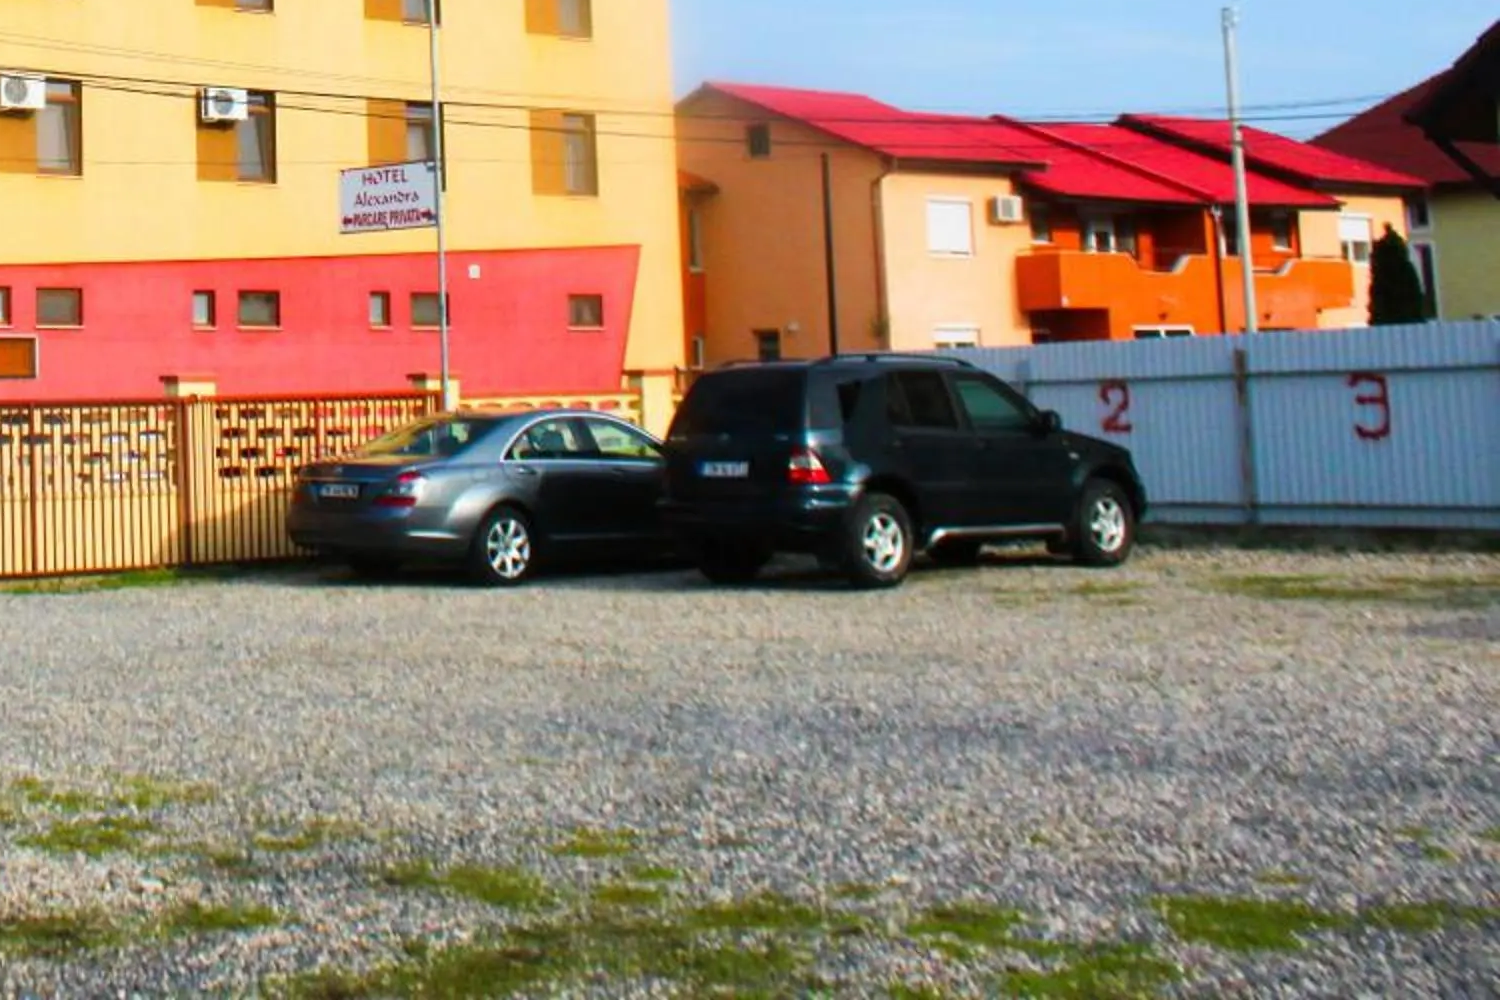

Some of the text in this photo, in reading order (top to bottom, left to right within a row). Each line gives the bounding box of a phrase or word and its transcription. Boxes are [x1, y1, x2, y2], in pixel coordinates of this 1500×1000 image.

[362, 169, 408, 186] HOTEL
[354, 190, 420, 208] Alexandra
[1100, 379, 1132, 433] 2
[1346, 371, 1390, 440] 3
